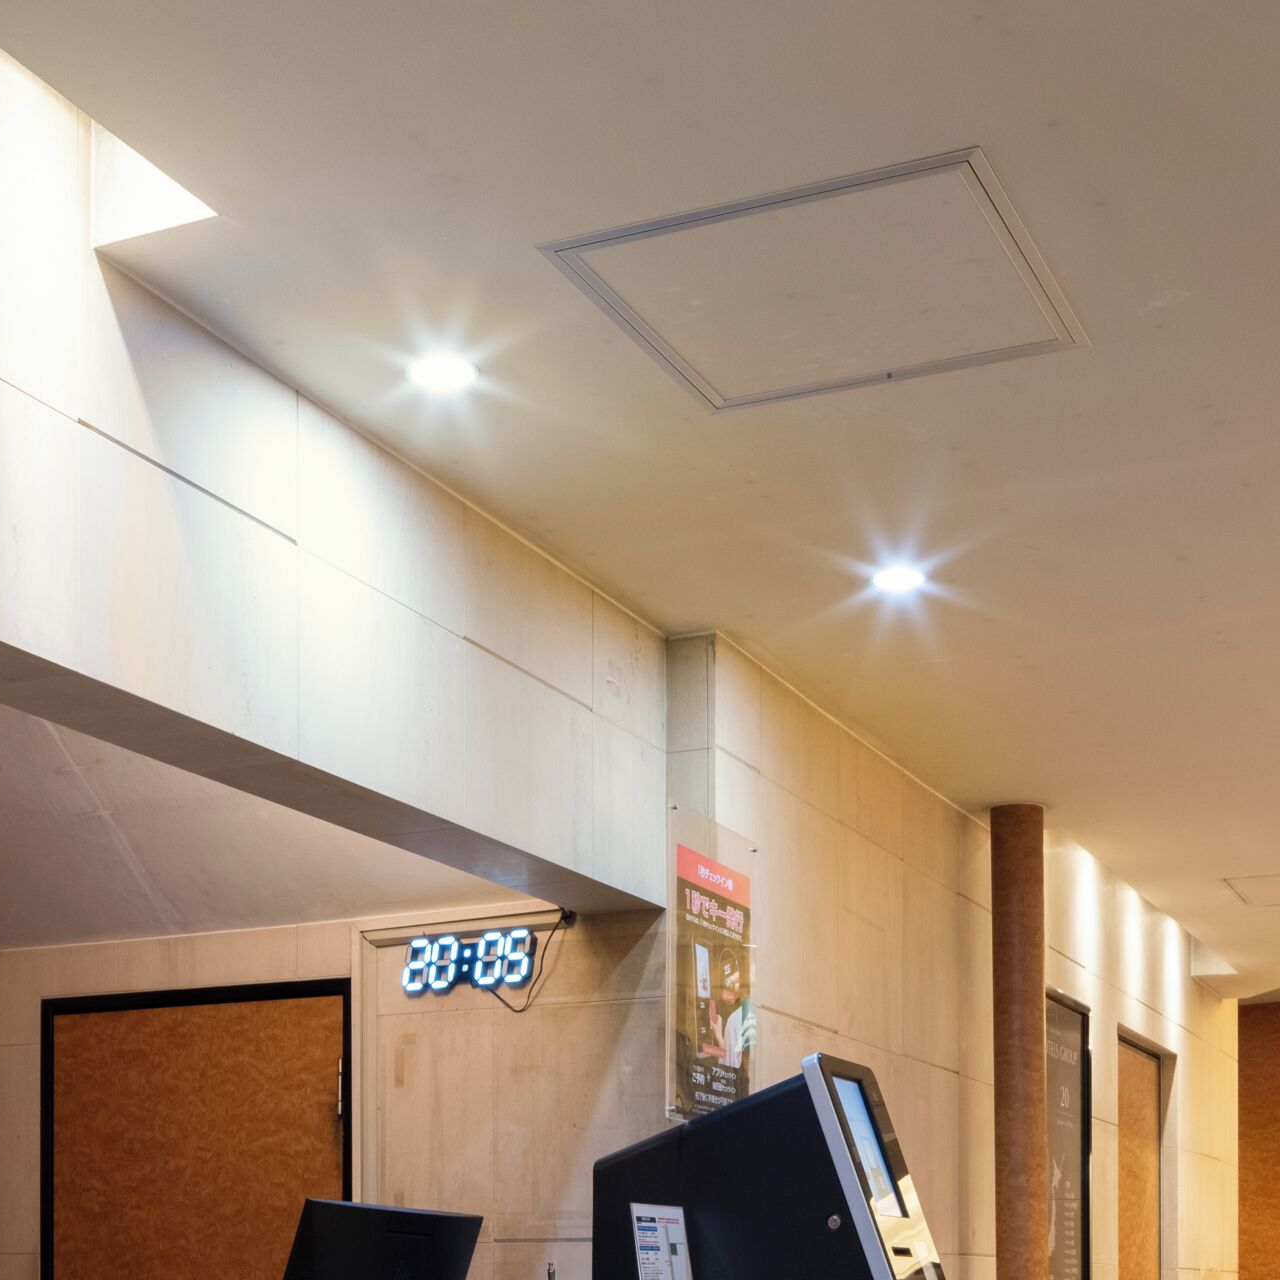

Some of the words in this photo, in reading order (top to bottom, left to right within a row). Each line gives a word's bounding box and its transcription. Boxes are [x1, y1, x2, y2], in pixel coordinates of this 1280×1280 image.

[684, 888, 745, 933] 1秒でキー発行
[402, 928, 530, 993] 20:05
[1046, 1039, 1059, 1059] TELS
[1060, 1086, 1070, 1108] 20
